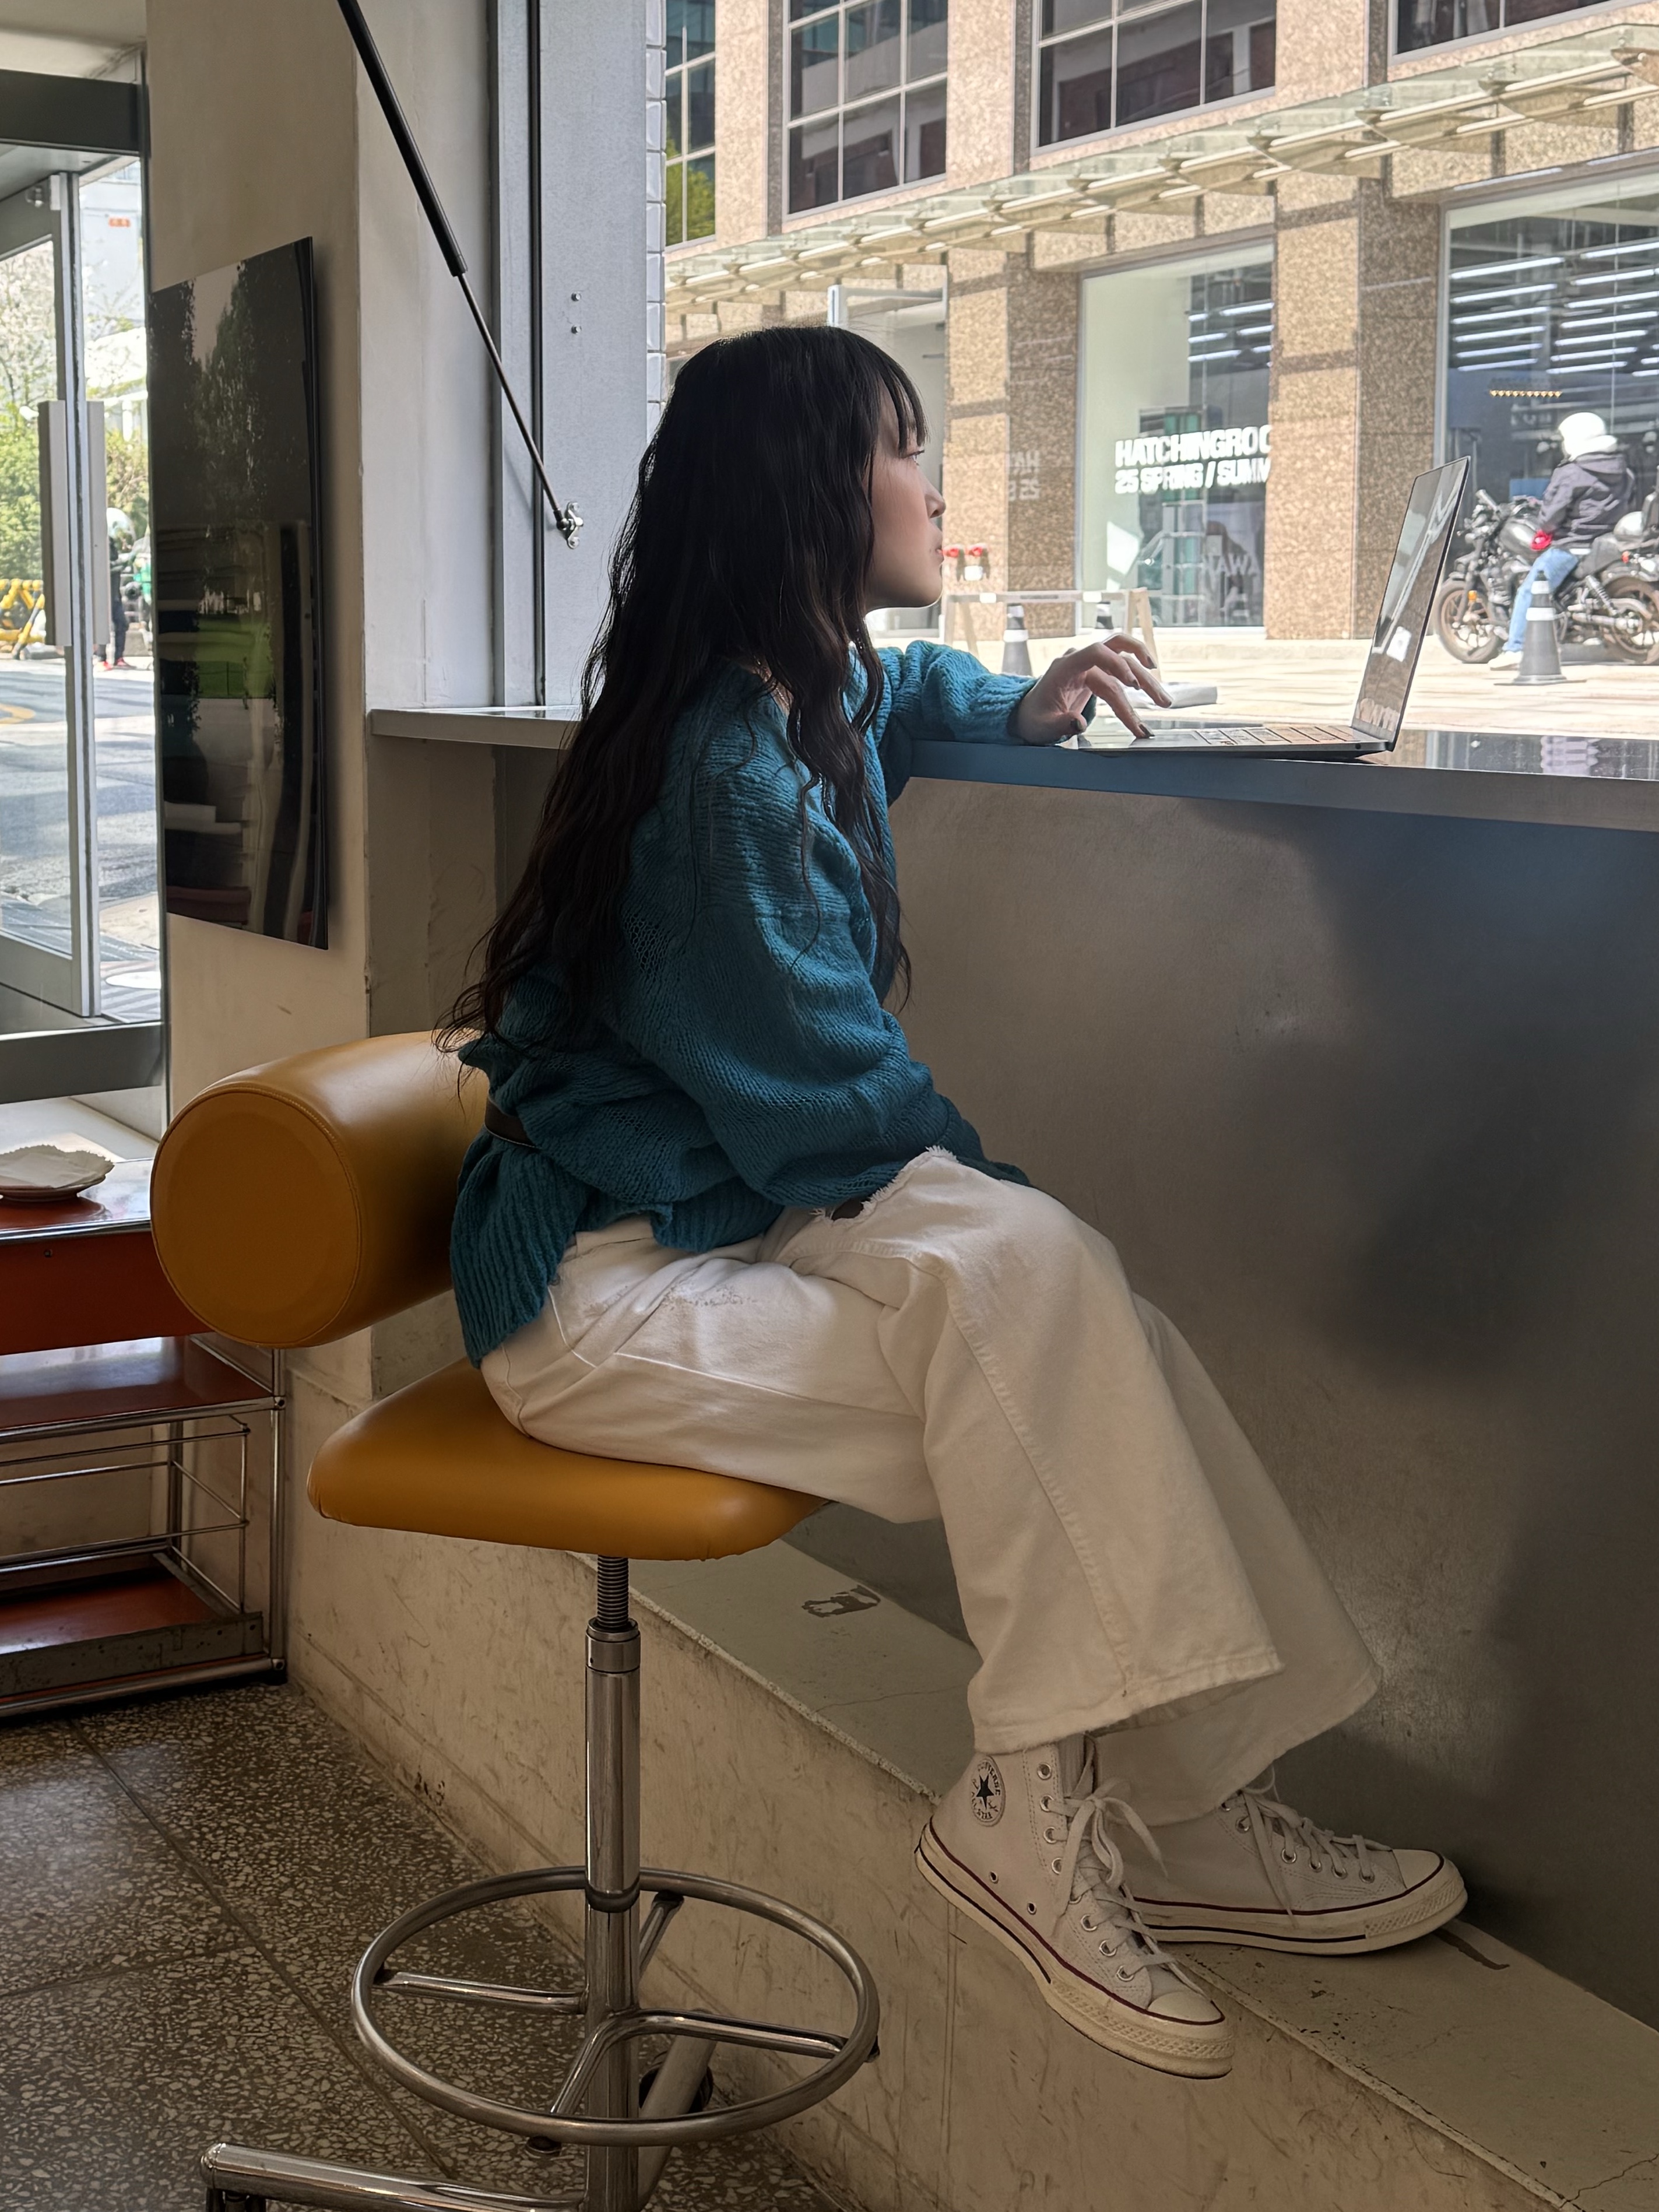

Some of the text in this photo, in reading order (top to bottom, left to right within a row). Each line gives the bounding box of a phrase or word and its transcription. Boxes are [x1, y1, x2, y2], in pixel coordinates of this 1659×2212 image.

[1115, 469, 1139, 494] 25
[1140, 462, 1204, 494] SPRING
[1204, 461, 1217, 489] /
